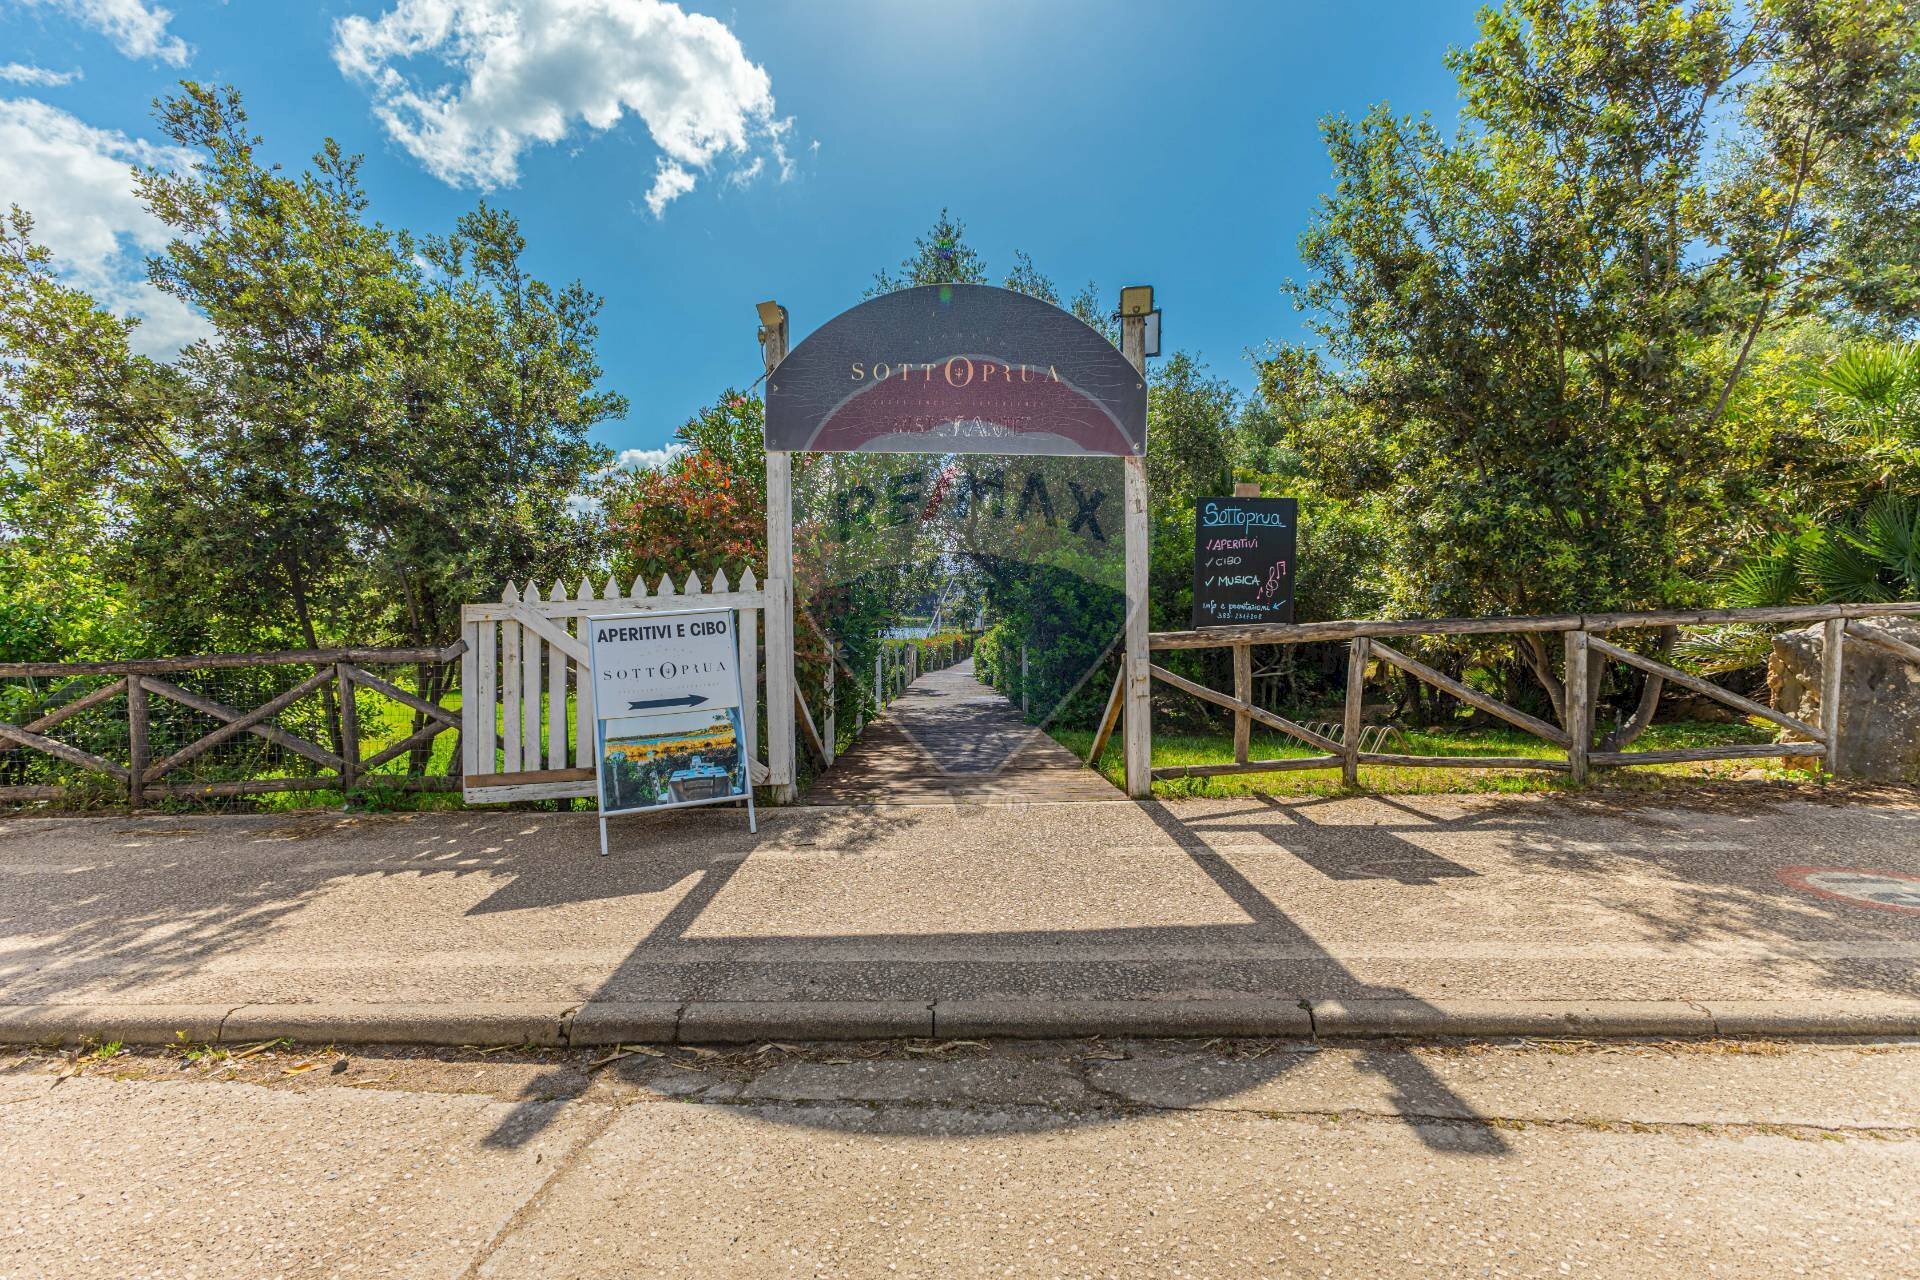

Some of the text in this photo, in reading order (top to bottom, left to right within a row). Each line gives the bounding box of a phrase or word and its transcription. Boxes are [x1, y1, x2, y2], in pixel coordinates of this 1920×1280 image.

[851, 355, 1060, 388] SOTTOPRUA
[1202, 502, 1283, 535] Sottoprua
[1215, 556, 1242, 566] CIBO
[1218, 575, 1261, 587] MUSICA
[597, 620, 727, 643] APERITIVI E CIBO
